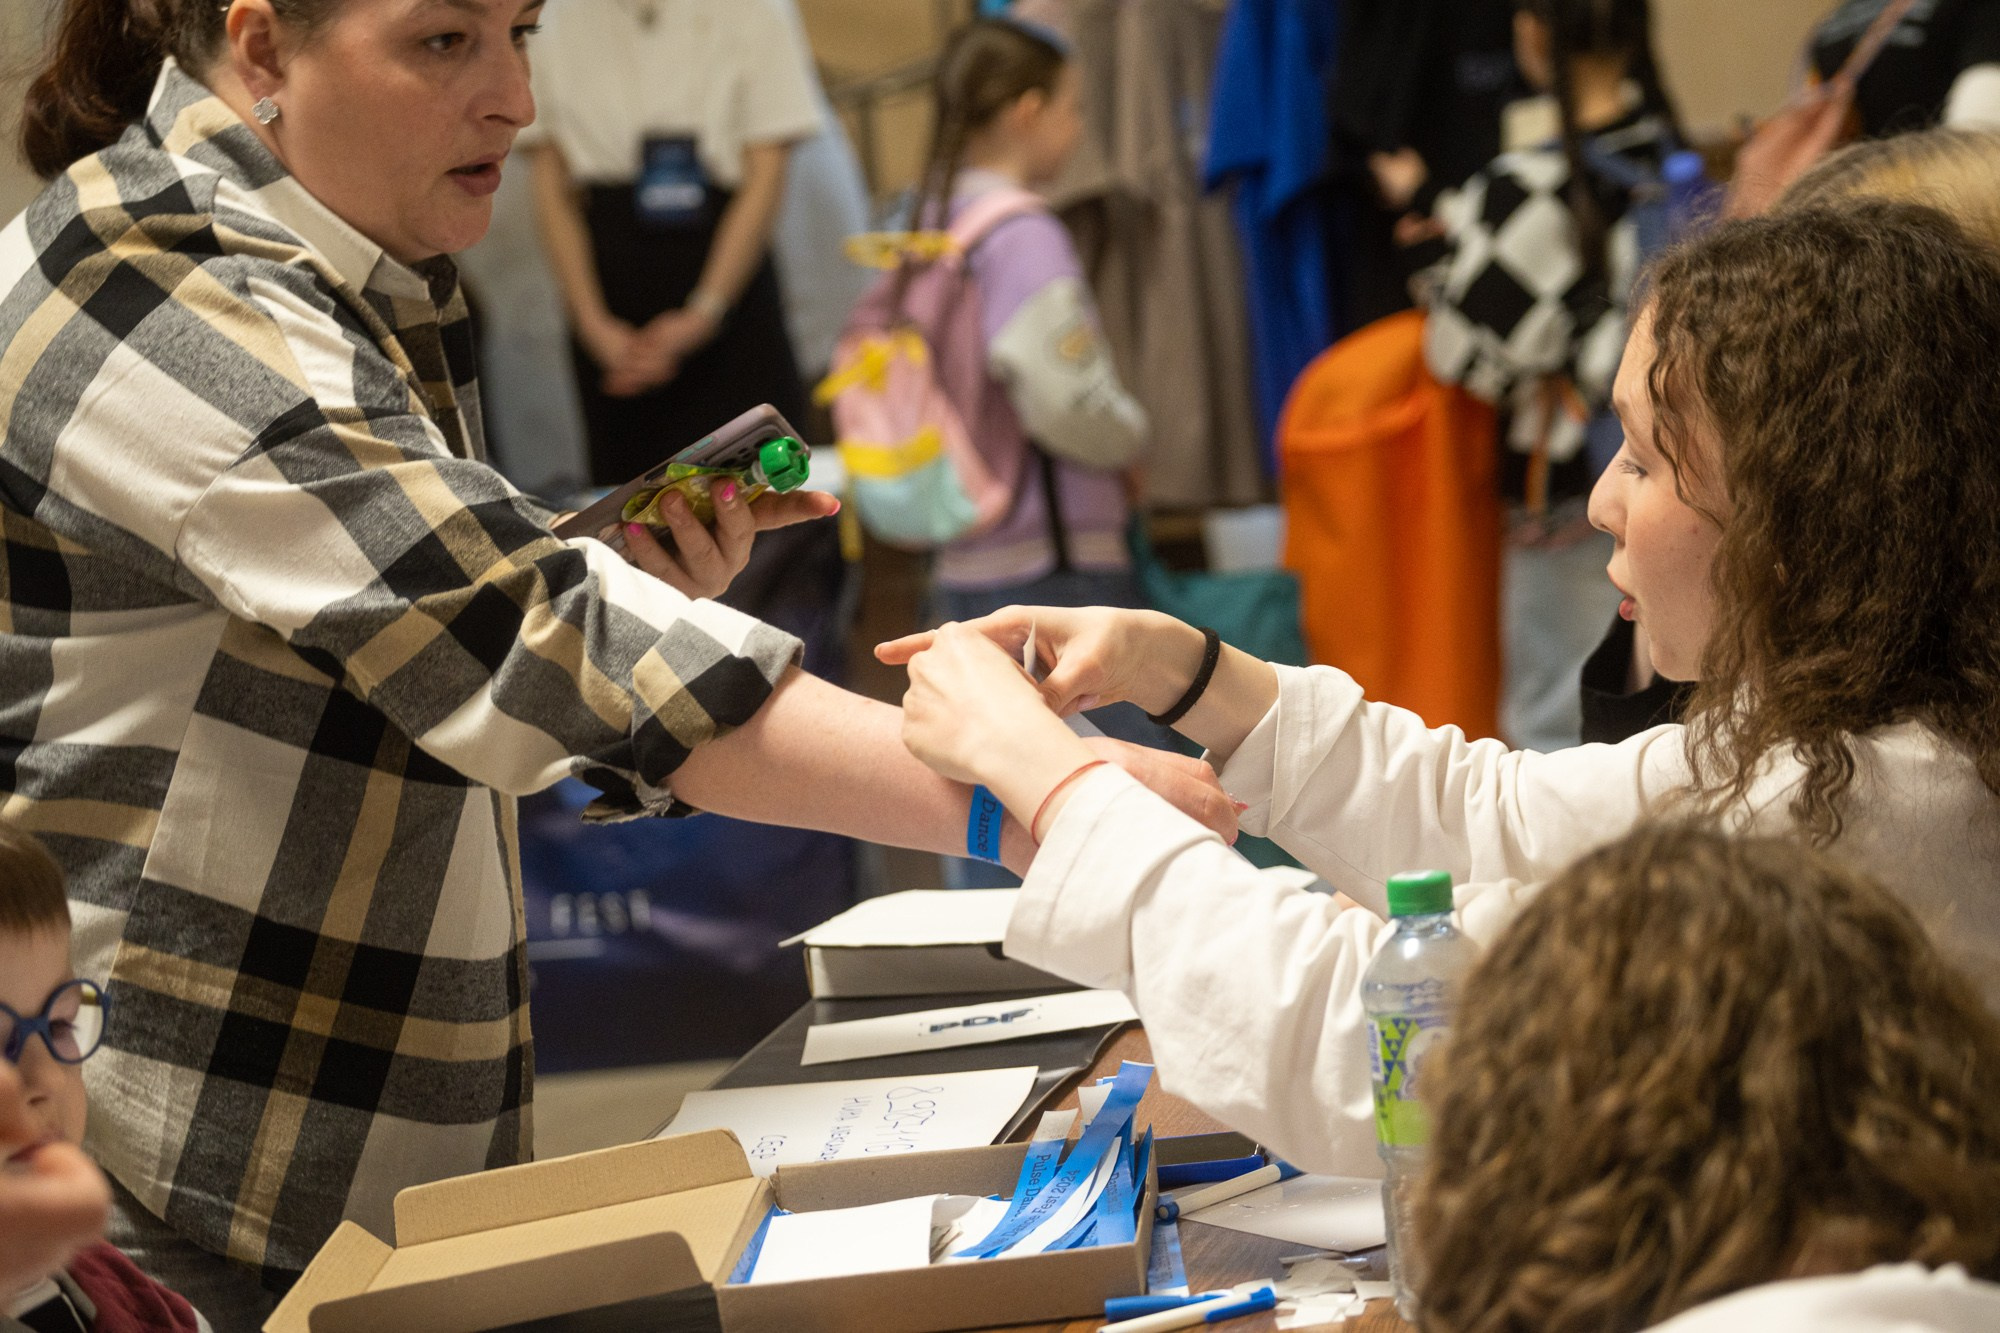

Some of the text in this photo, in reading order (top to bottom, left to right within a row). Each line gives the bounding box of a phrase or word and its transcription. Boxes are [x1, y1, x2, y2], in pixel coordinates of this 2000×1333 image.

[977, 797, 996, 852] Dance
[929, 1008, 1034, 1033] PDF
[1029, 1154, 1052, 1185] Pulse
[1031, 1195, 1061, 1214] Fest
[1050, 1169, 1081, 1194] 2024
